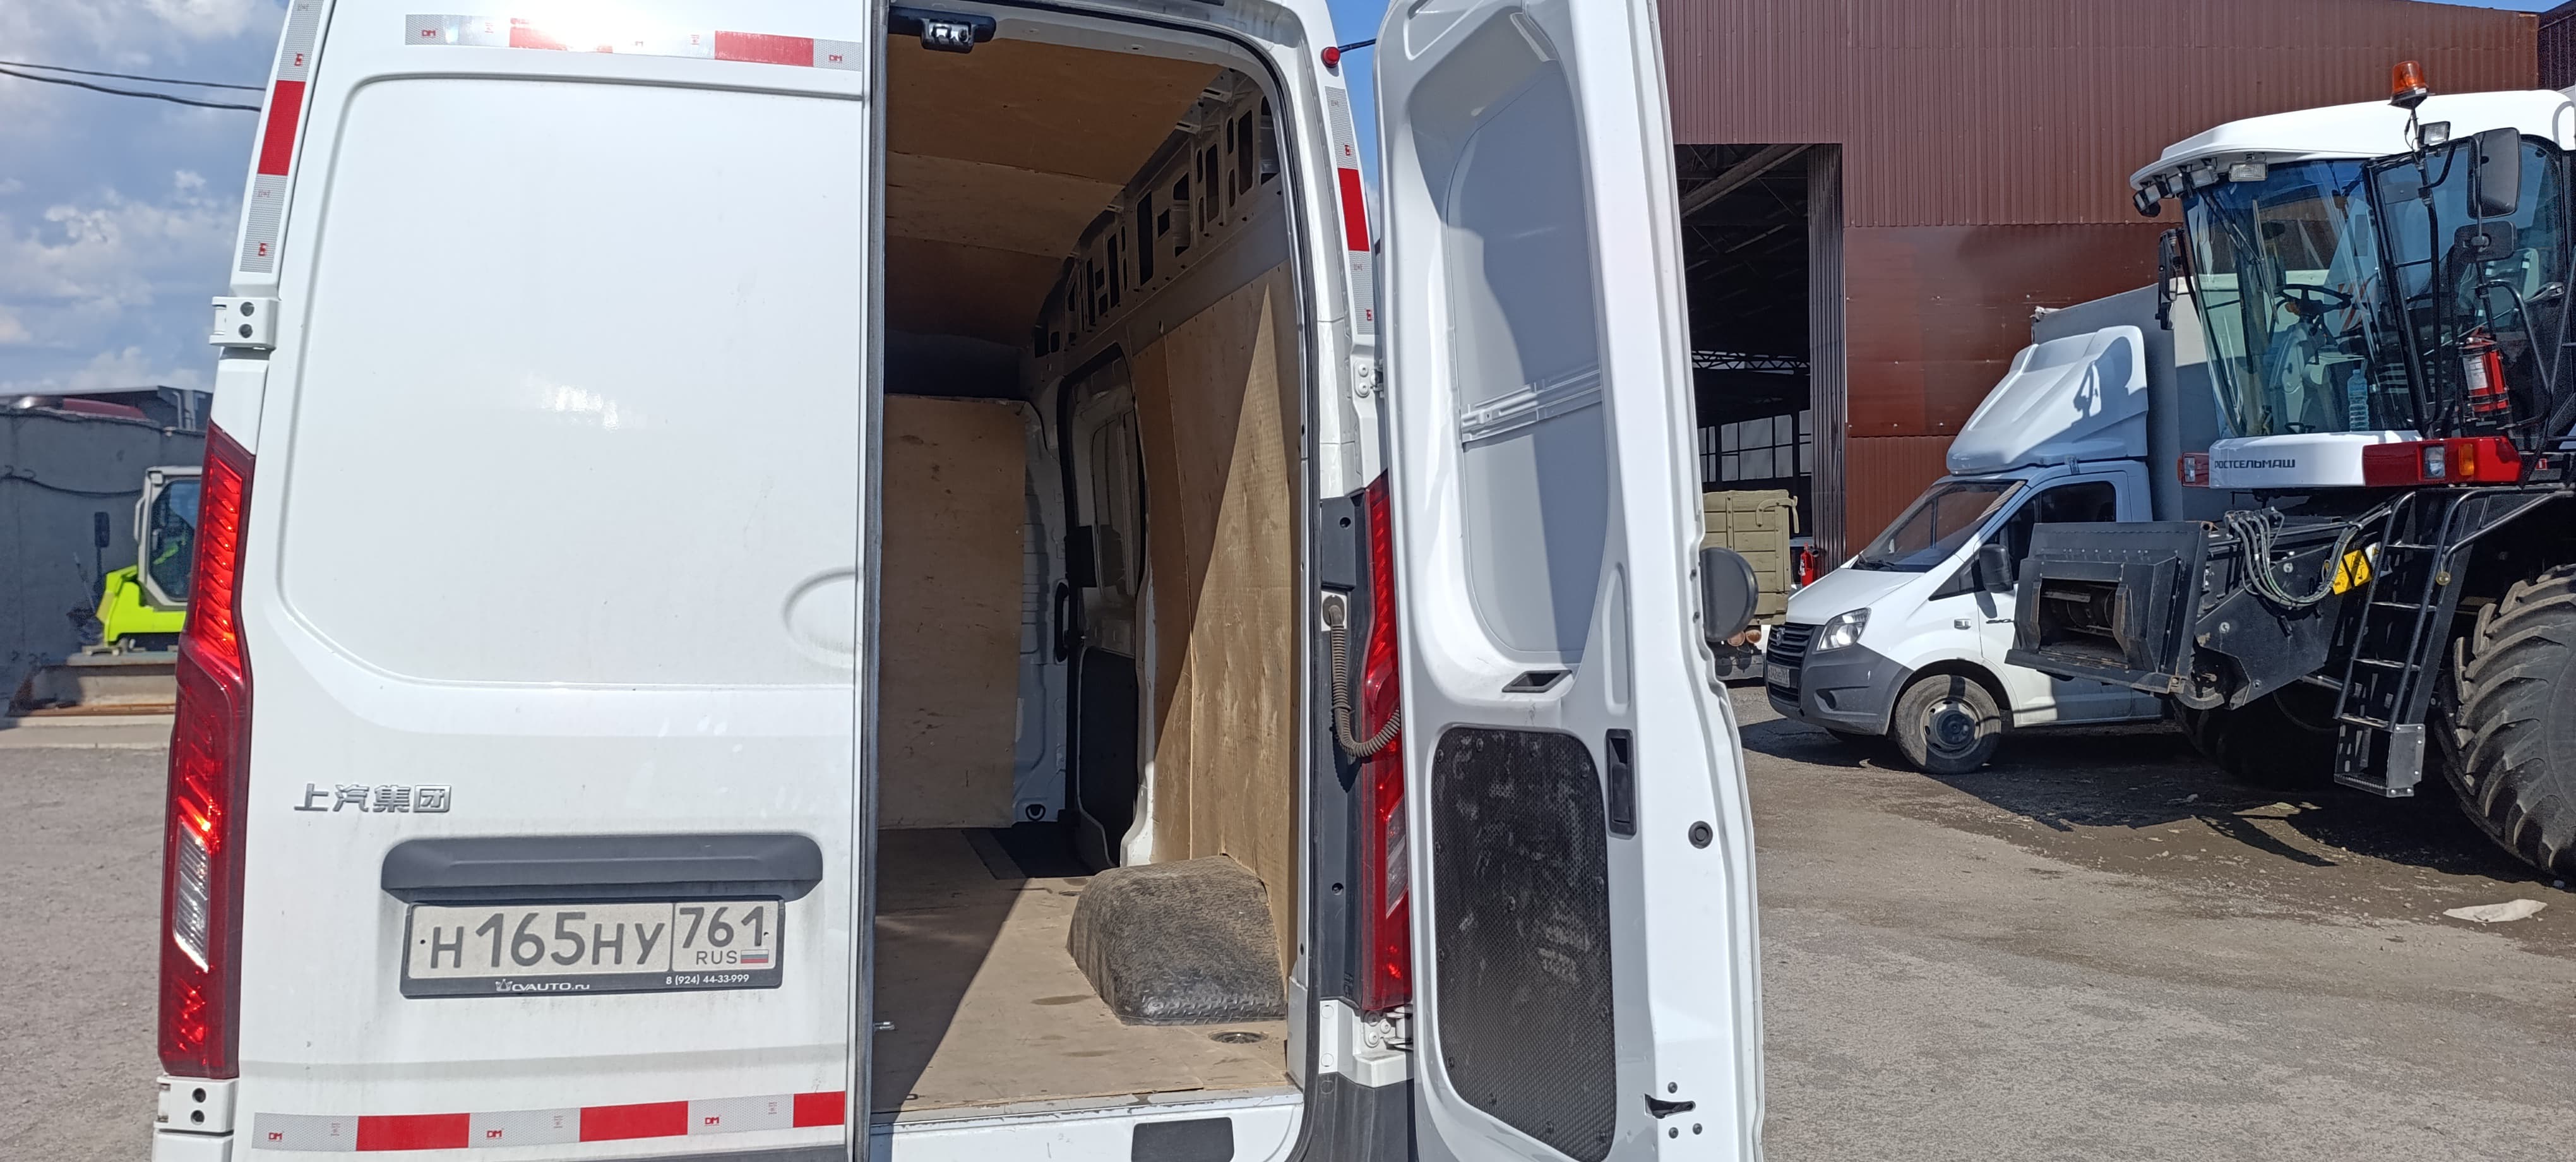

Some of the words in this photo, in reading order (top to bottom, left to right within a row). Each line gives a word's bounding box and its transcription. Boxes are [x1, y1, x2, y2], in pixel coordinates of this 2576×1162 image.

[2214, 459, 2296, 469] РОСТСЕЛЬМАШ
[294, 783, 451, 813] 上汽集团
[679, 906, 763, 949] 761
[696, 950, 737, 965] RUS
[665, 976, 672, 985] 8
[675, 974, 700, 985] (924)
[703, 974, 749, 983] 44-33-999
[705, 1117, 720, 1125] DM
[268, 1132, 283, 1141] DM
[487, 1130, 503, 1139] DM
